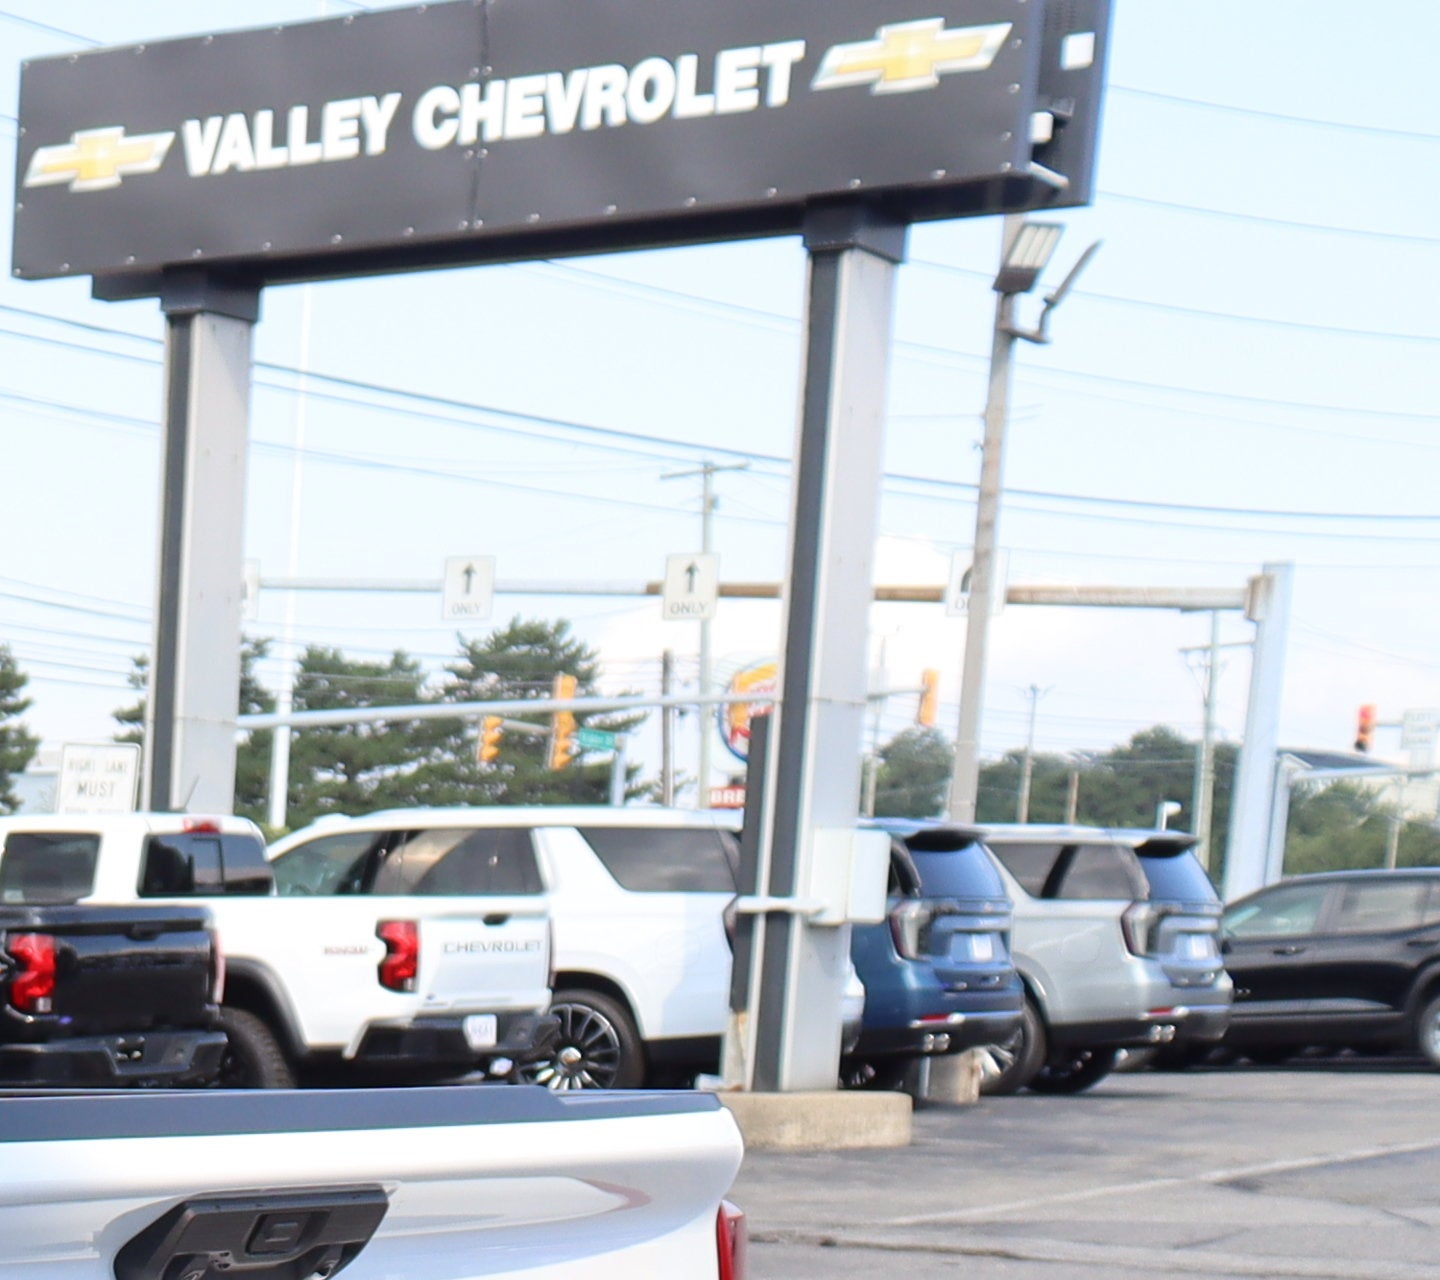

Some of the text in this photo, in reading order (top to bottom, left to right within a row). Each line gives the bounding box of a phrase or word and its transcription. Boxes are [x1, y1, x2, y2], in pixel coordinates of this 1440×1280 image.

[183, 39, 807, 177] VALLEY CHEVROLET
[78, 780, 115, 798] MUST
[443, 940, 543, 954] CHEVROLET
